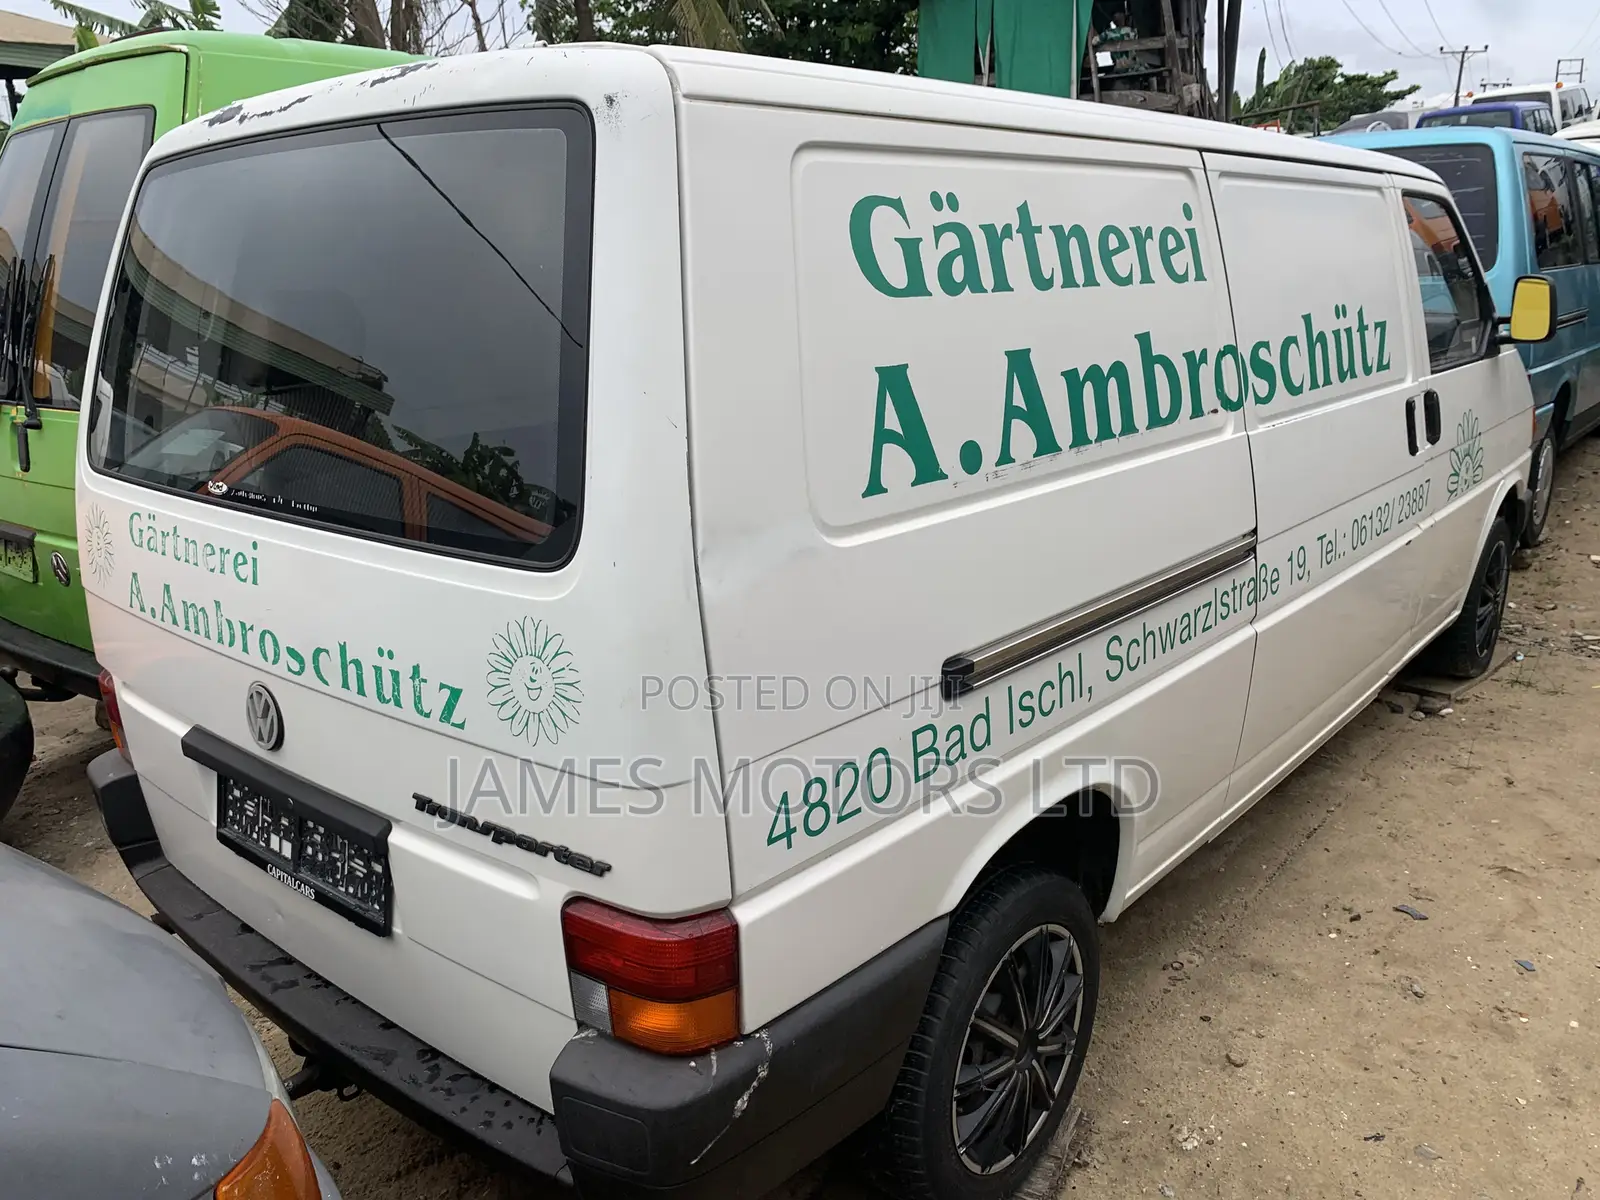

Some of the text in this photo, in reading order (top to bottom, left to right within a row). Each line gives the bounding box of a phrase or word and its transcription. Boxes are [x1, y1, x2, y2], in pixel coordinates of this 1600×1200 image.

[849, 190, 1208, 299] Gärtnerei
[861, 304, 1393, 500] A.Ambroschütz
[128, 510, 260, 586] Gärtnerei
[128, 571, 467, 731] A.Ambroschütz
[765, 746, 894, 850] 4820
[911, 703, 992, 784] Bad
[1007, 652, 1094, 736] Ischl,
[1105, 562, 1280, 683] Schwarzlstraße
[1287, 545, 1312, 584] 19,
[412, 792, 613, 877] Transporter
